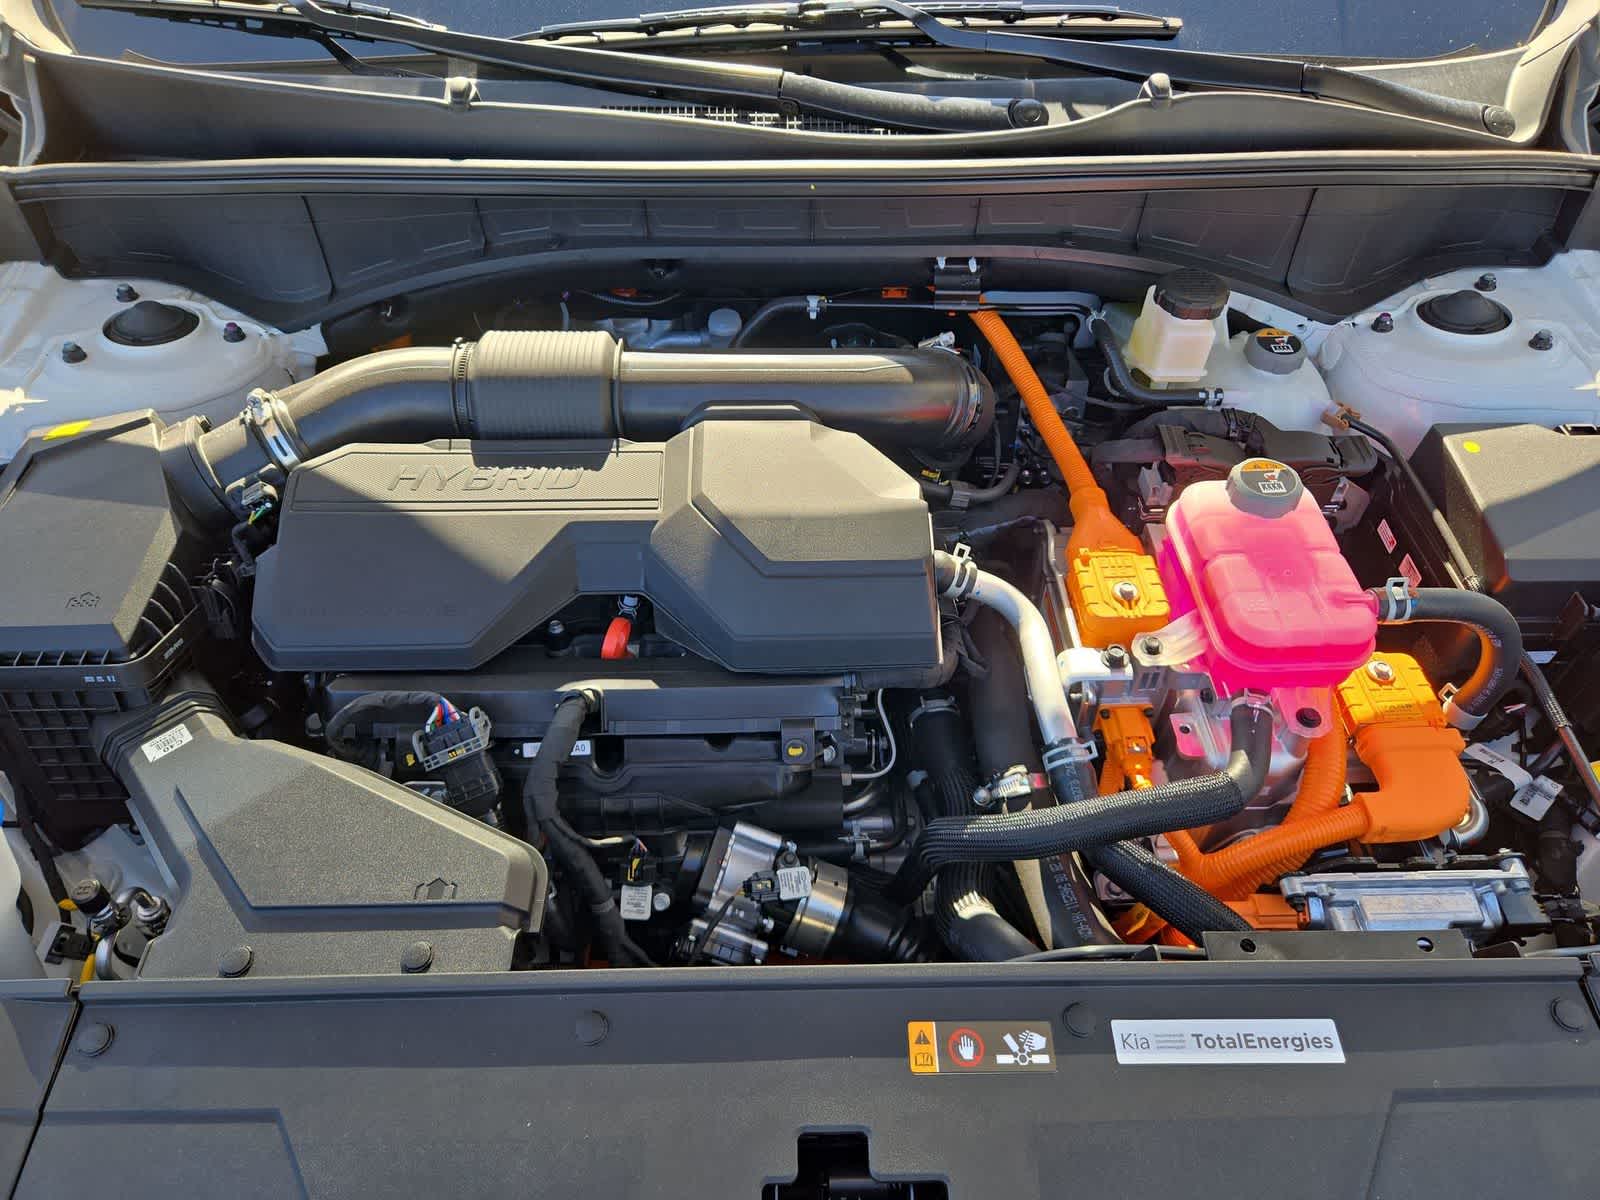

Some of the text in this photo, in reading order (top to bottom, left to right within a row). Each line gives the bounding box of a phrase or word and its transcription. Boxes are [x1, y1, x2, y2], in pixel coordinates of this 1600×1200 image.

[387, 465, 584, 491] HYBRID
[1120, 1033, 1150, 1050] Kia
[1191, 1032, 1334, 1052] TotalEnergies
